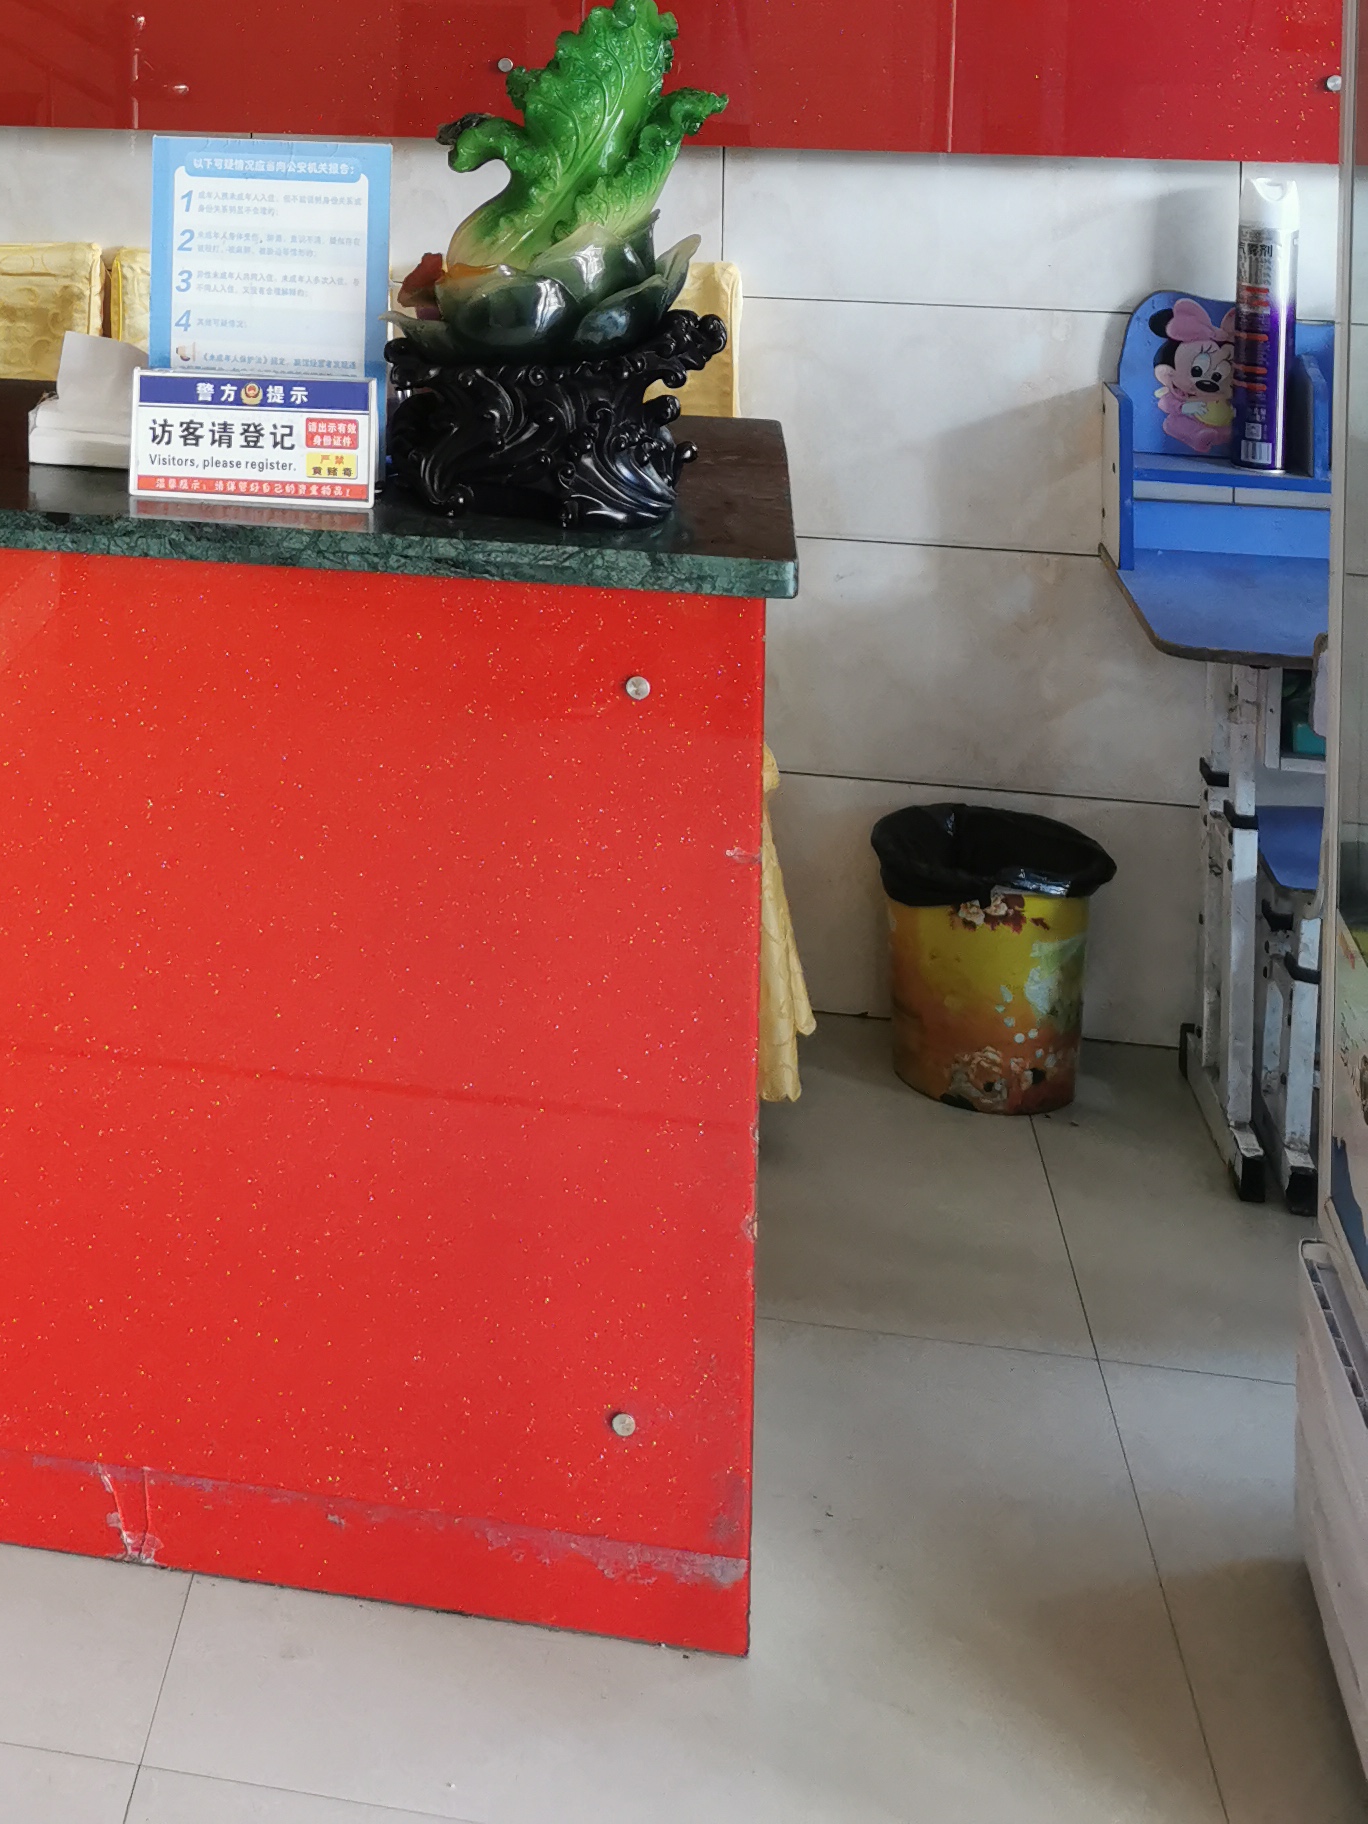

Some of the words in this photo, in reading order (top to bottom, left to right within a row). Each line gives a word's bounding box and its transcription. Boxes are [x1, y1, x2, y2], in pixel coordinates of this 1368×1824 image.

[180, 189, 194, 212] 1
[177, 228, 195, 251] 2
[175, 269, 193, 292] 3
[174, 309, 192, 332] 4
[196, 382, 238, 403] 警方
[266, 385, 309, 405] 提示
[149, 419, 296, 450] 访客请登记
[308, 422, 357, 435] 请出示有效
[312, 435, 353, 447] 身份证件
[149, 454, 200, 468] Visitors,
[203, 456, 242, 470] please
[245, 459, 297, 473] register.
[320, 454, 345, 466] 严禁
[311, 466, 354, 478] 黄赌毒
